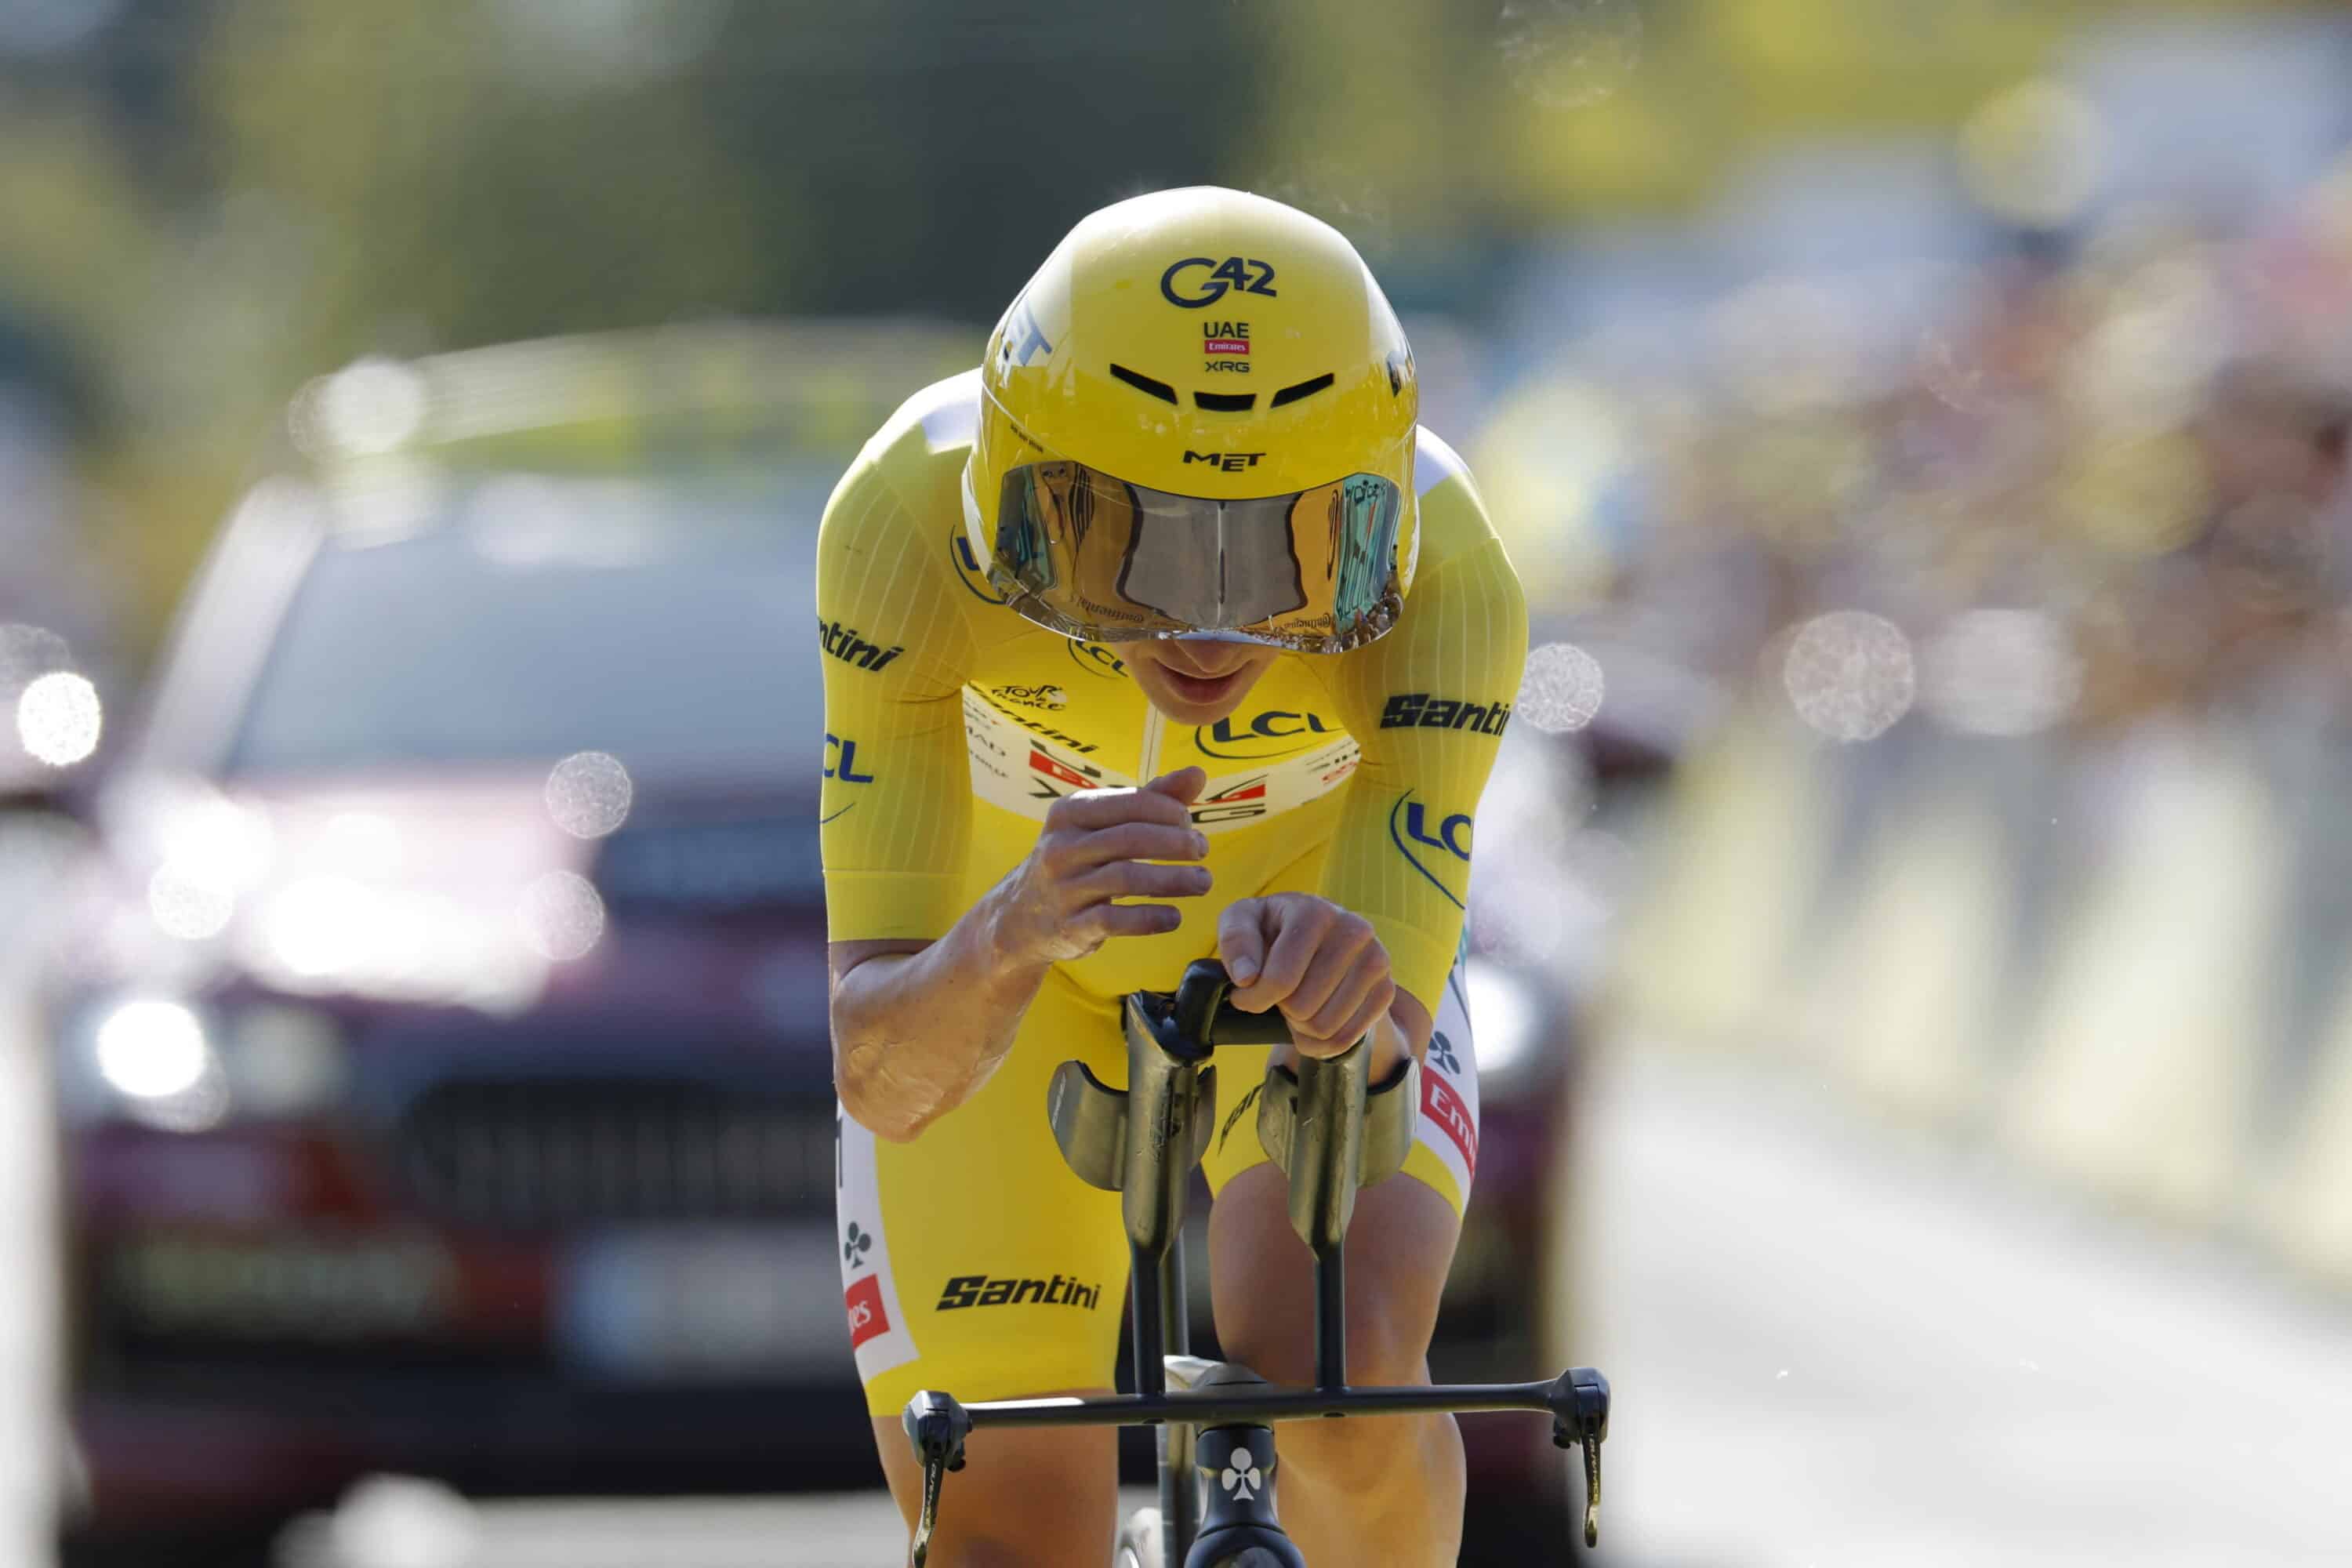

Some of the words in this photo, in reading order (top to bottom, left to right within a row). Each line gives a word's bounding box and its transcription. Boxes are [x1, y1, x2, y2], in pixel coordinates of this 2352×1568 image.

[1160, 257, 1277, 308] G42
[1203, 321, 1250, 339] UAE
[1208, 342, 1247, 352] Emirates
[1204, 361, 1250, 372] XRG
[1183, 450, 1267, 472] MET
[1212, 710, 1344, 743] LCL
[1379, 693, 1511, 737] Santi
[935, 1274, 1100, 1312] Santini
